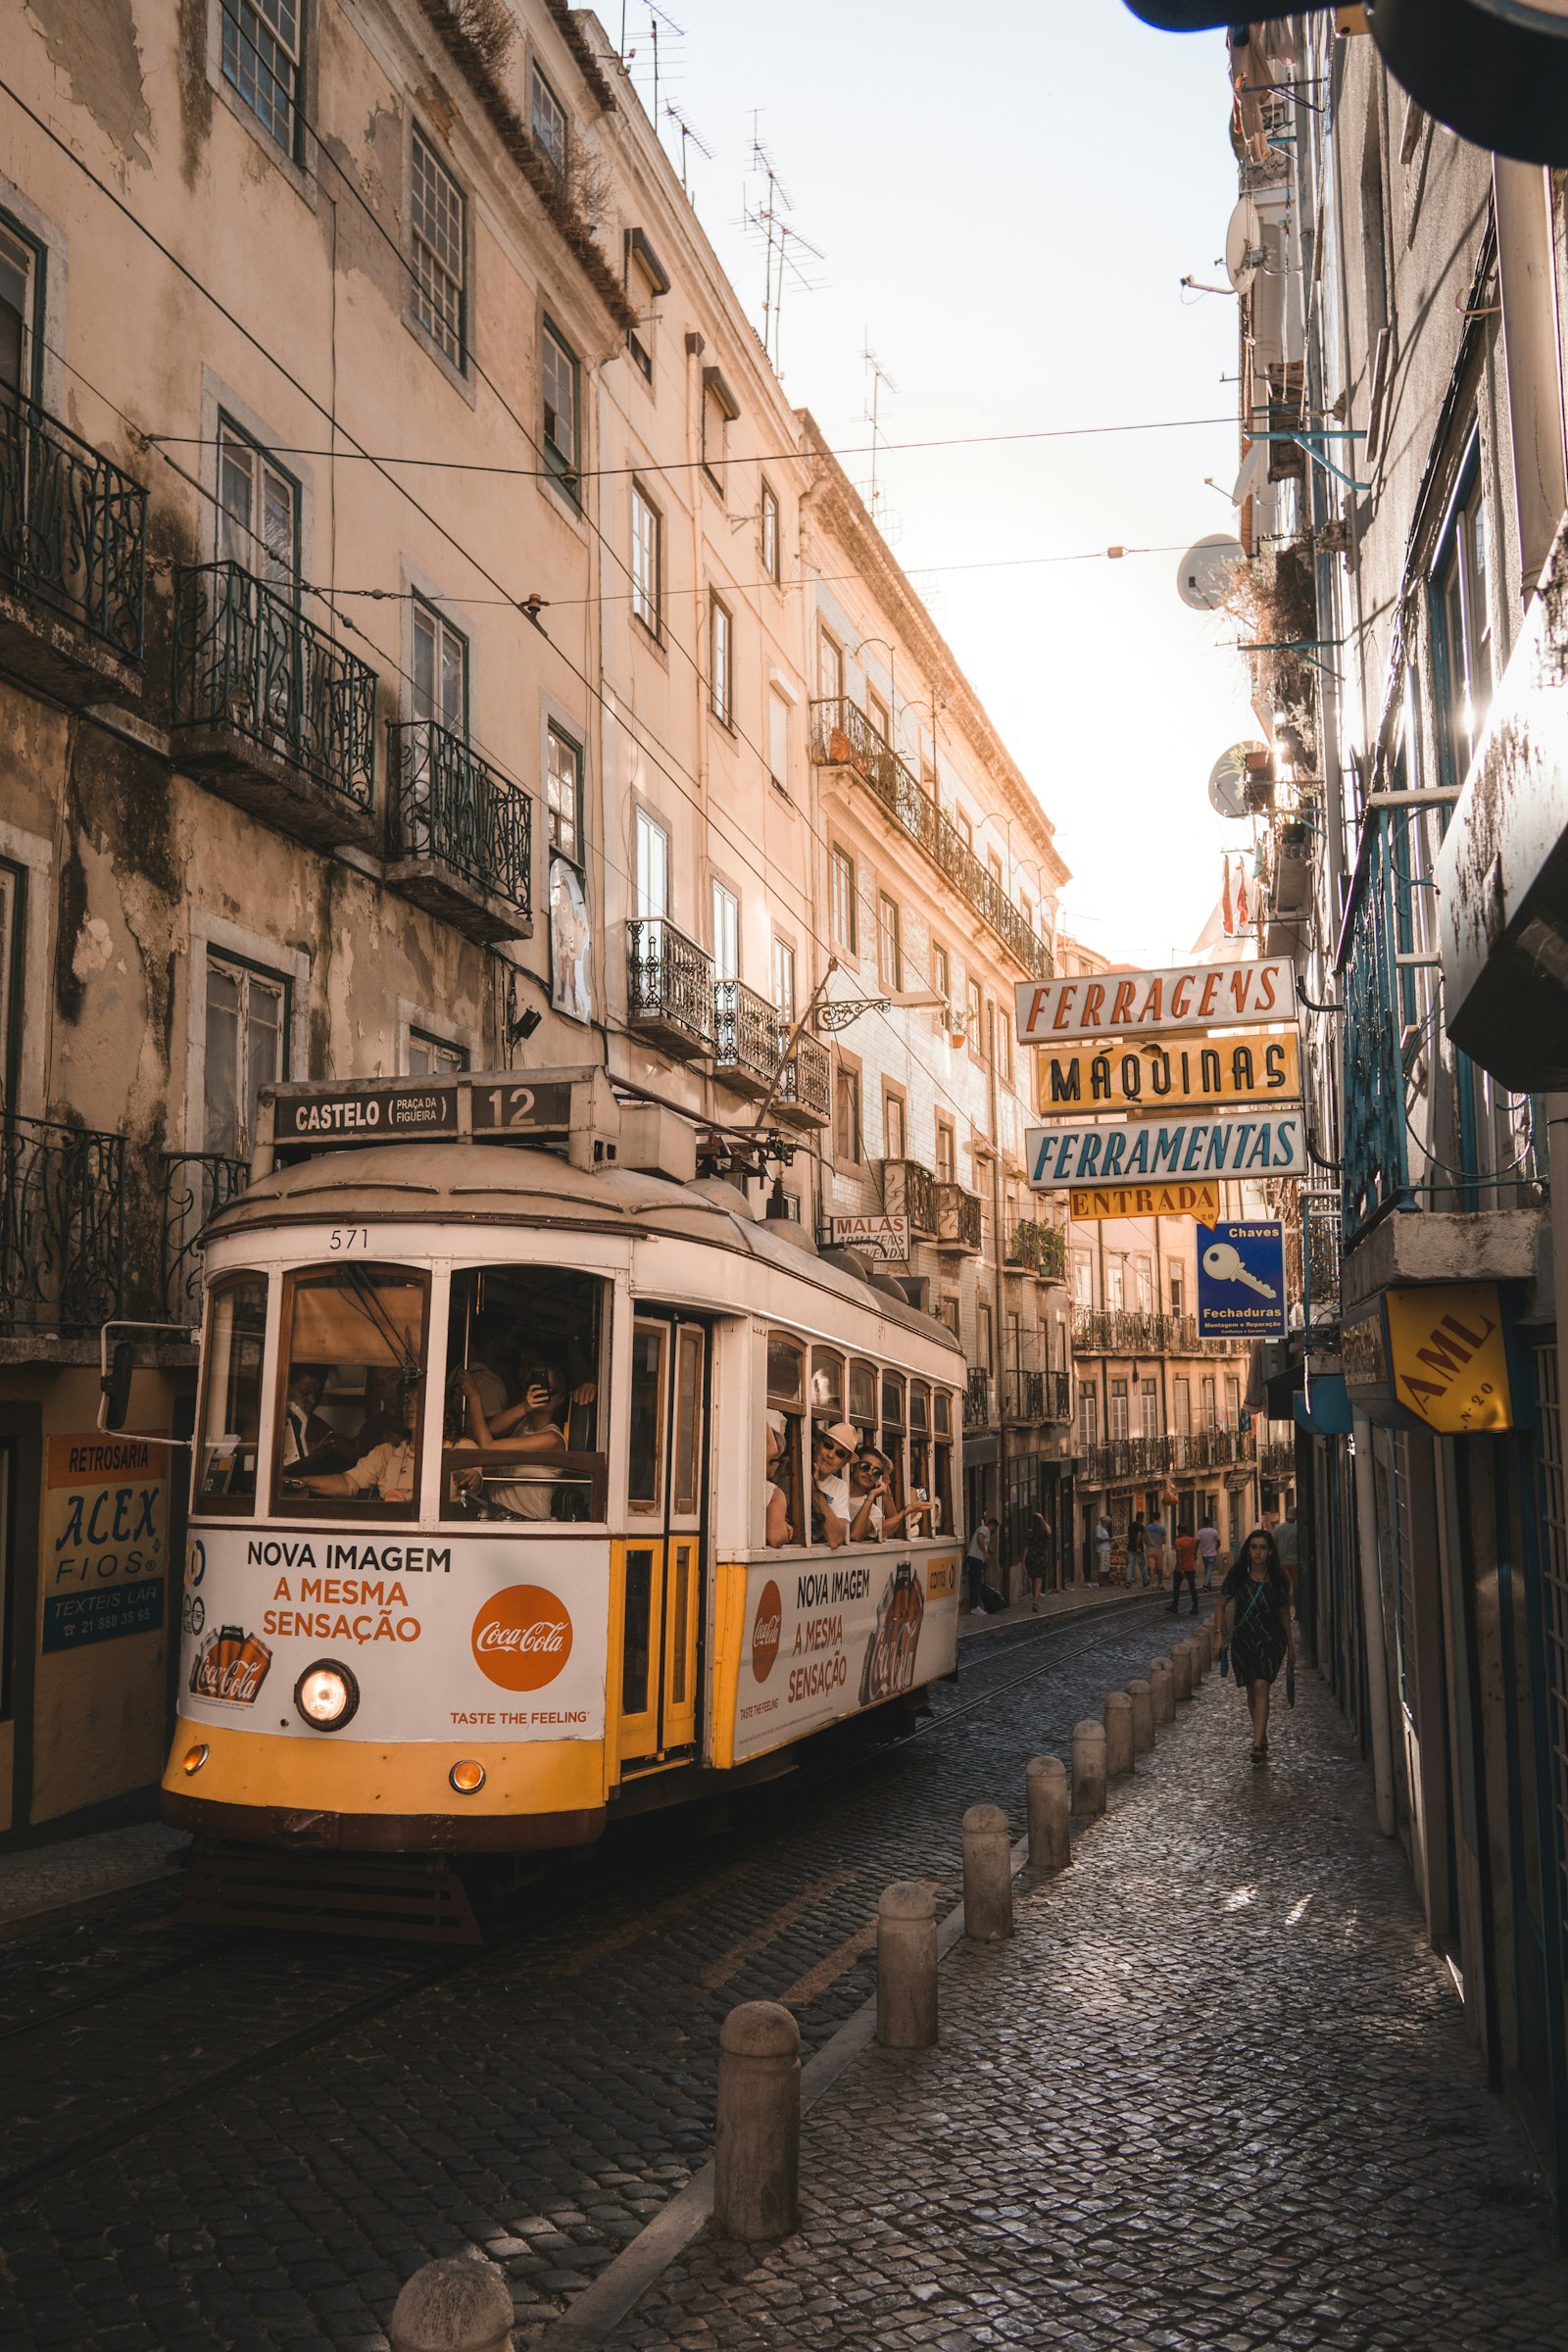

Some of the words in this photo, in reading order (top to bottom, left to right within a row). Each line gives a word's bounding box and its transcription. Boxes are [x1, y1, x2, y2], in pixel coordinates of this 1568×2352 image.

[1025, 966, 1280, 1032] FERRAGENS
[1051, 1044, 1286, 1103] MÁQUINAS
[295, 1102, 380, 1132] CASTELO
[488, 1088, 536, 1128] 12
[1032, 1120, 1296, 1181] FERRAMENTAS
[1073, 1186, 1215, 1216] ENTRADA
[329, 1229, 368, 1250] 571
[837, 1218, 904, 1234] MALAS
[1228, 1227, 1280, 1238] Chaves
[1202, 1307, 1282, 1318] Fechaduras
[1399, 1314, 1496, 1416] AML
[69, 1444, 149, 1473] RETROSARIA
[55, 1487, 160, 1551] ACEX
[247, 1542, 317, 1569] NOVA
[326, 1544, 452, 1573] IMAGEM
[54, 1592, 122, 1618] TEXTEIS
[126, 1586, 157, 1604] LAR
[273, 1577, 293, 1602] A
[300, 1578, 409, 1607] MESMA
[797, 1571, 828, 1609] NOVA
[831, 1569, 870, 1603] IMAGEM
[80, 1619, 94, 1634] 21
[98, 1614, 118, 1630] 888
[263, 1609, 421, 1645] SENSAÇÃO
[476, 1620, 569, 1653] Coca-Cola
[792, 1623, 802, 1656] A
[806, 1614, 843, 1650] MESMA
[787, 1650, 847, 1704] SENSAÇÃO
[450, 1711, 495, 1725] TASTE
[499, 1711, 528, 1725] THE
[530, 1711, 587, 1725] FEELING
[740, 1705, 754, 1721] TASTE
[761, 1698, 779, 1713] FEELING
